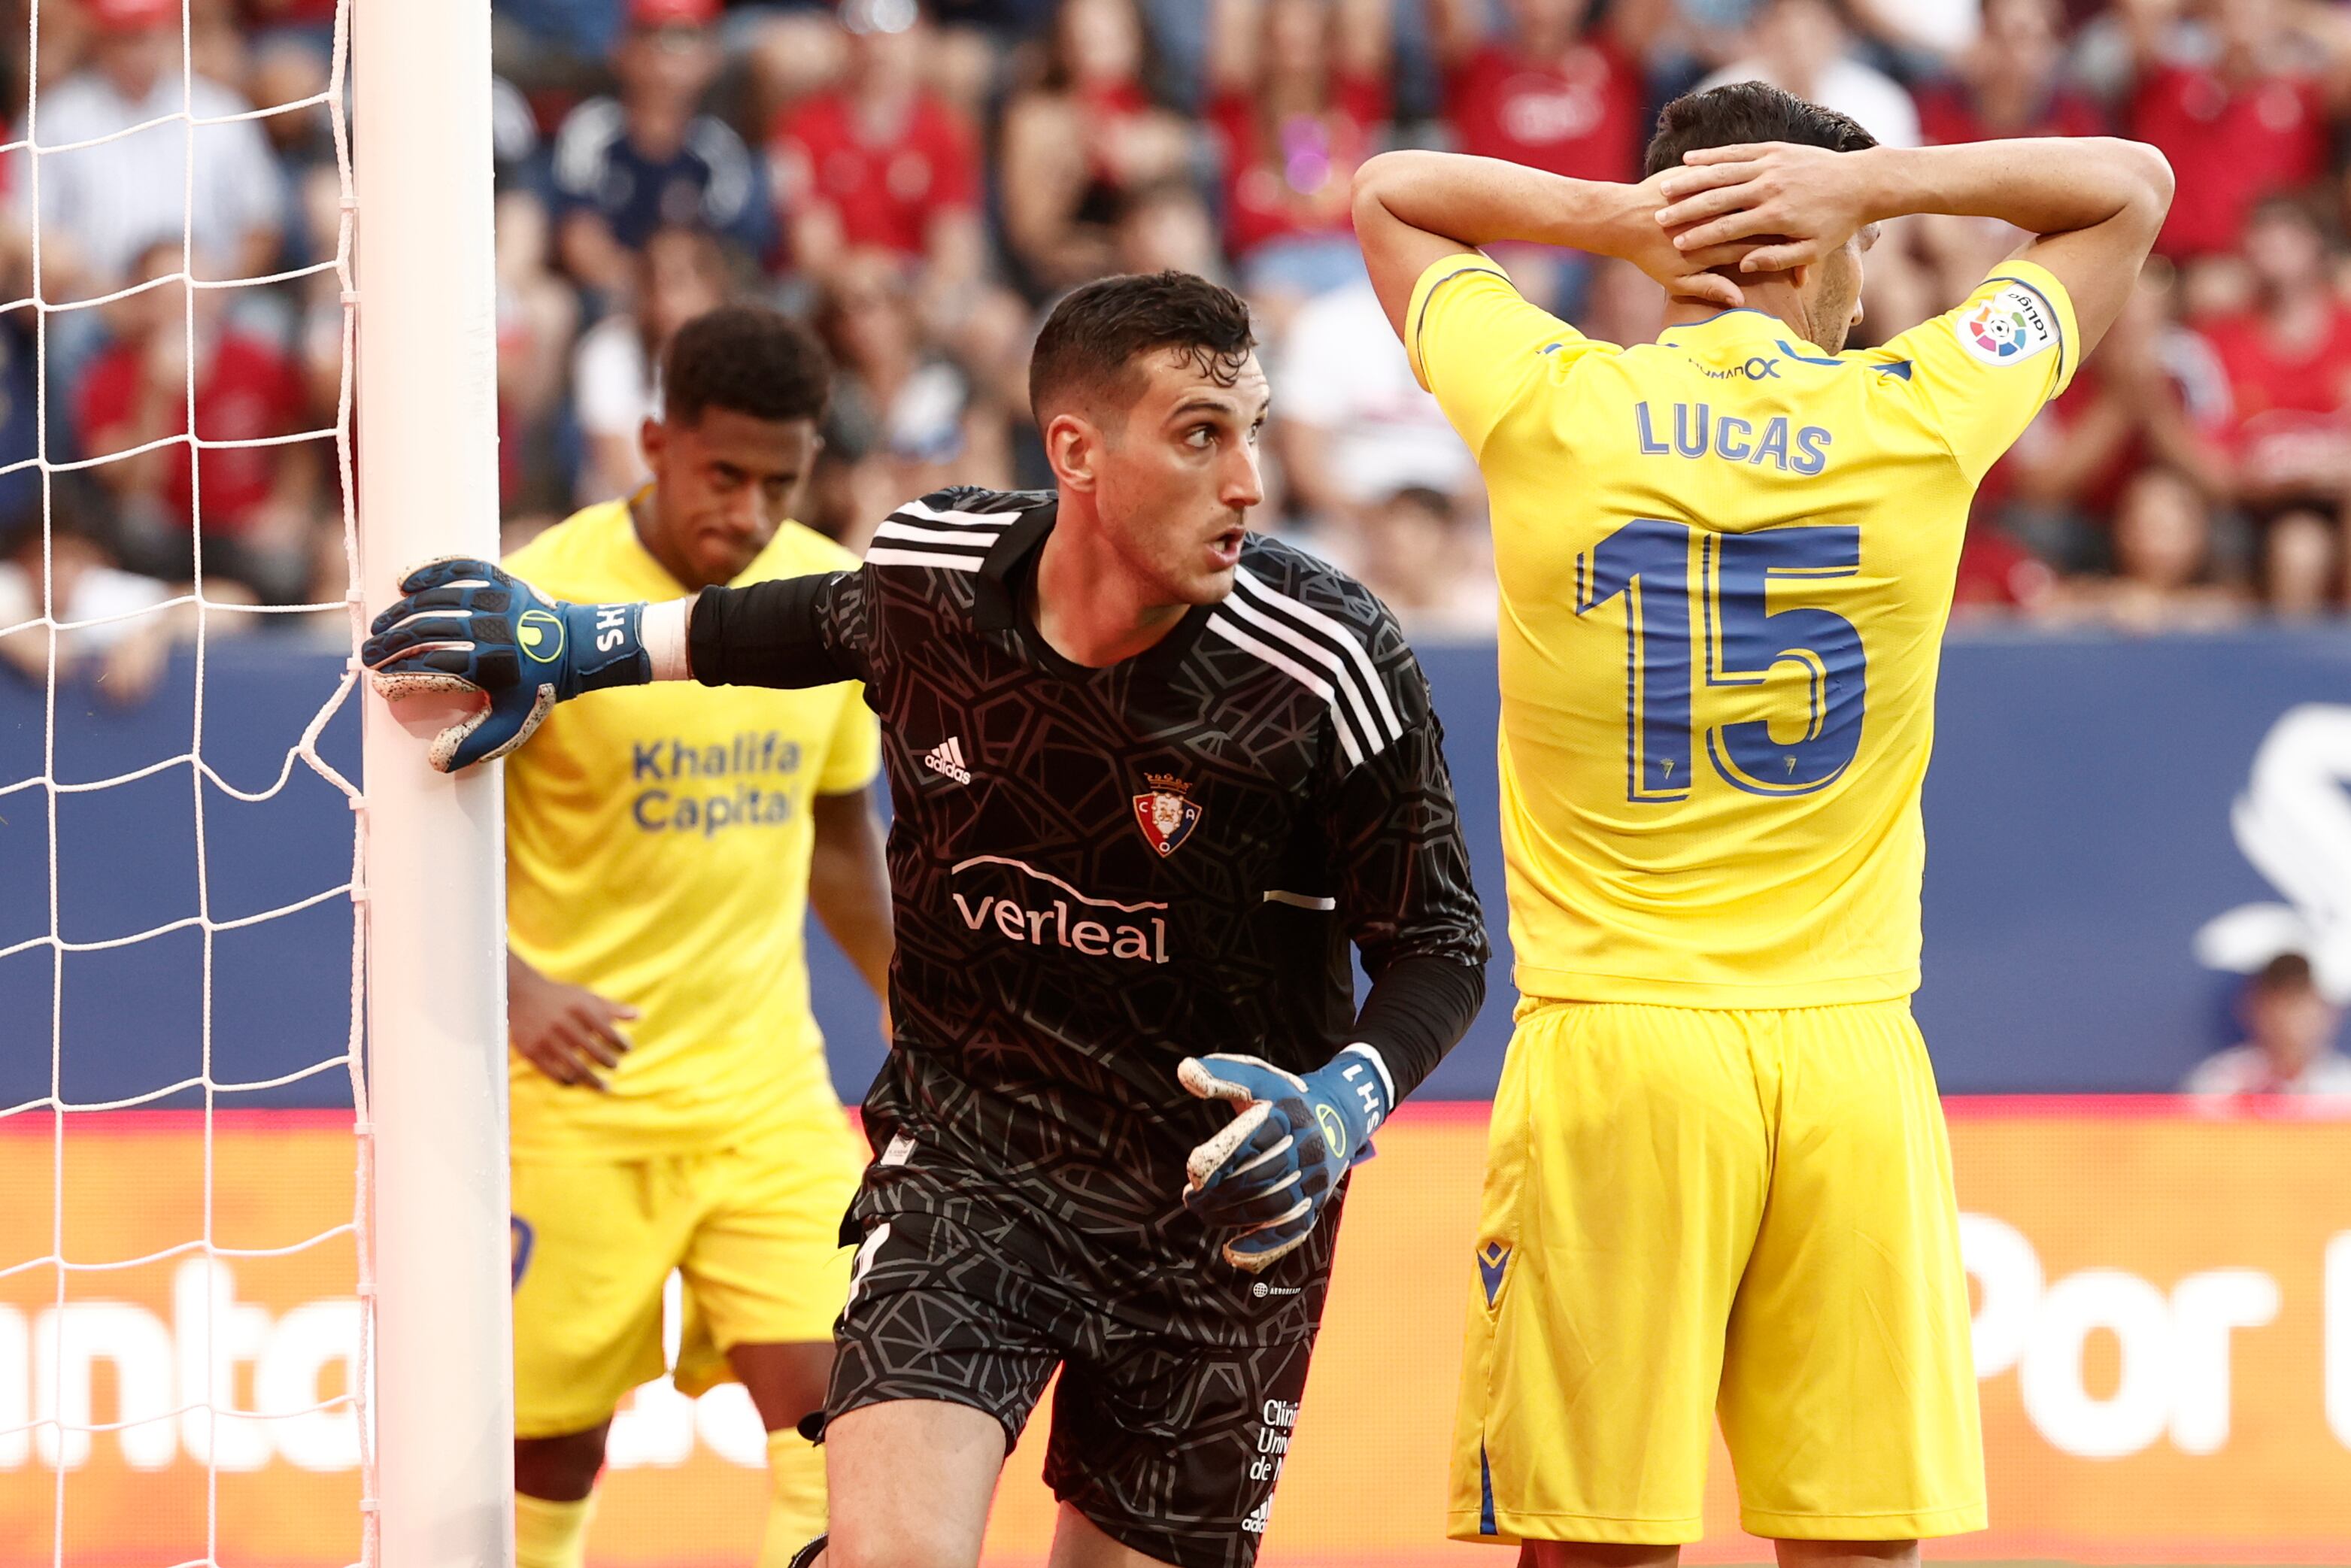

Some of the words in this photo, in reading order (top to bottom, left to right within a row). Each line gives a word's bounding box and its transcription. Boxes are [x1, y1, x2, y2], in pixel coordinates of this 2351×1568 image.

[2007, 293, 2049, 341] LaLiga
[1634, 400, 1833, 475] LUCAS
[1575, 518, 1867, 803] 15
[632, 730, 802, 781] Khalifa
[924, 754, 972, 786] adidas
[951, 893, 1169, 965] verleal
[1249, 1455, 1272, 1481] de
